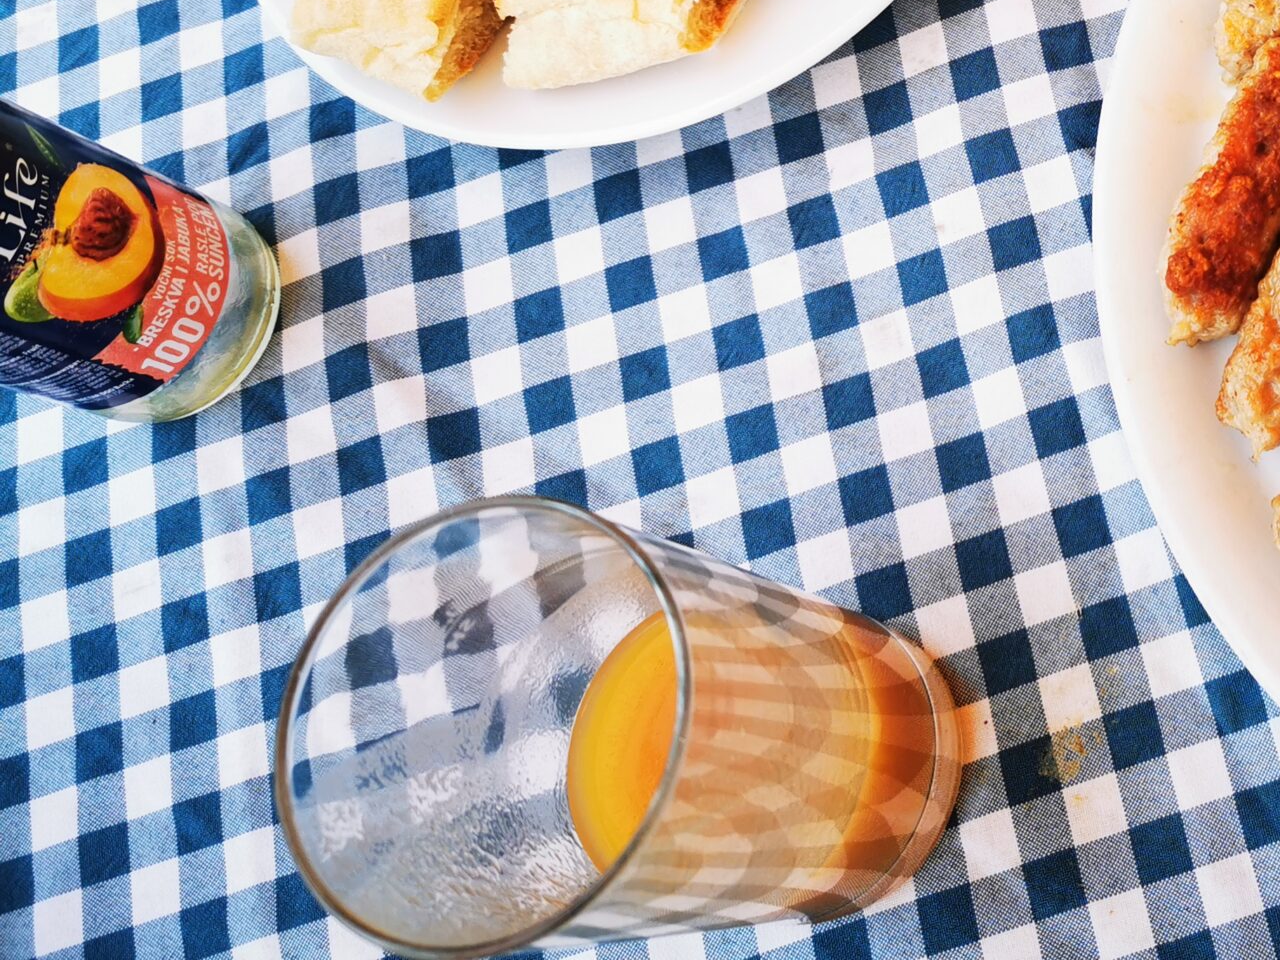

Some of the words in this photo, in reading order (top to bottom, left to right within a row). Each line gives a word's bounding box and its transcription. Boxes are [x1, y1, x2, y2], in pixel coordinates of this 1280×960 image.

[16, 174, 50, 265] PREMIUM
[172, 205, 191, 265] JABUKA
[165, 238, 176, 263] SOK
[175, 265, 189, 275] I
[194, 225, 209, 275] RASLE
[136, 278, 186, 347] BRESKVA
